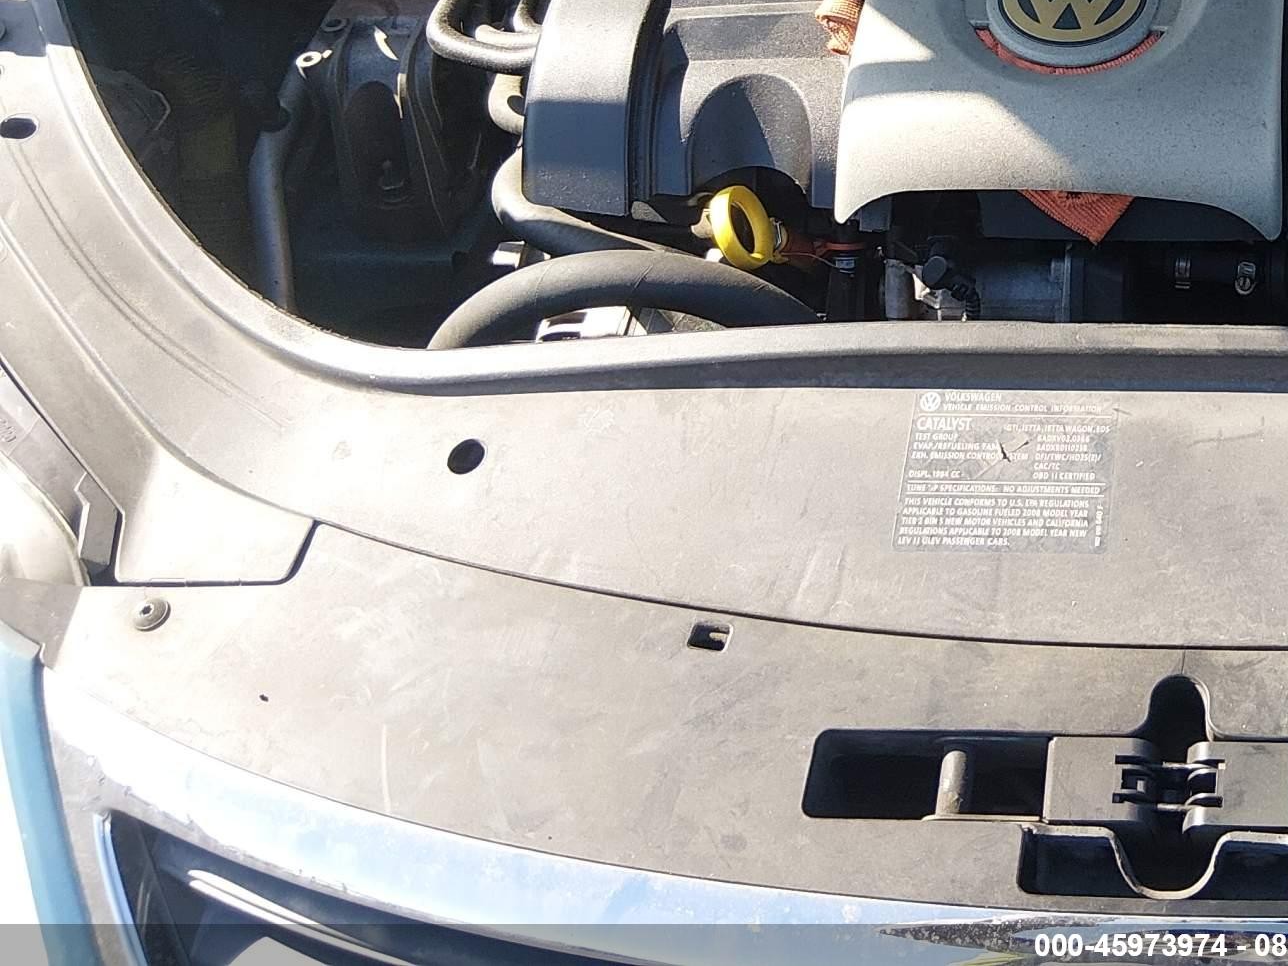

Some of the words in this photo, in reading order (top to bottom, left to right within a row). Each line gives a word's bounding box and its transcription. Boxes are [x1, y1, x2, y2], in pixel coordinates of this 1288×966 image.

[945, 392, 1002, 402] VOLKSWAGEN
[943, 403, 972, 411] VEHICLE
[1015, 404, 1048, 412] CONTROL
[1052, 404, 1102, 413] INFORMATION
[917, 417, 972, 430] CATALYST
[915, 433, 930, 441] TEST
[932, 433, 958, 441] GROUP
[930, 451, 965, 459] EMISSION
[1032, 472, 1049, 480] OBD
[1060, 472, 1096, 480] CERTIFIED
[907, 484, 926, 492] TUNE
[1003, 485, 1015, 493] NO
[1016, 486, 1068, 494] ADJUSTMENTS
[1070, 486, 1100, 494] NEEDED
[905, 497, 920, 505] THIS
[954, 498, 996, 506] CONFORMS
[1039, 499, 1089, 507] REGULATIONS
[902, 507, 944, 515] APPLICABLE
[995, 508, 1021, 516] FUELED
[1042, 509, 1067, 517] MODEL
[1069, 509, 1088, 517] YEAR
[992, 518, 1026, 526] VEHICLES
[1046, 519, 1088, 527] CALIFORNIA
[900, 527, 948, 535] REGULATIONS
[991, 528, 1001, 536] TO
[1022, 529, 1048, 537] MODEL
[1049, 529, 1068, 537] YEAR
[1070, 530, 1088, 538] NEW
[898, 536, 913, 544] LEV
[921, 537, 942, 545] ULEV
[942, 537, 984, 545] PASSENGER
[988, 538, 1010, 546] CARS.
